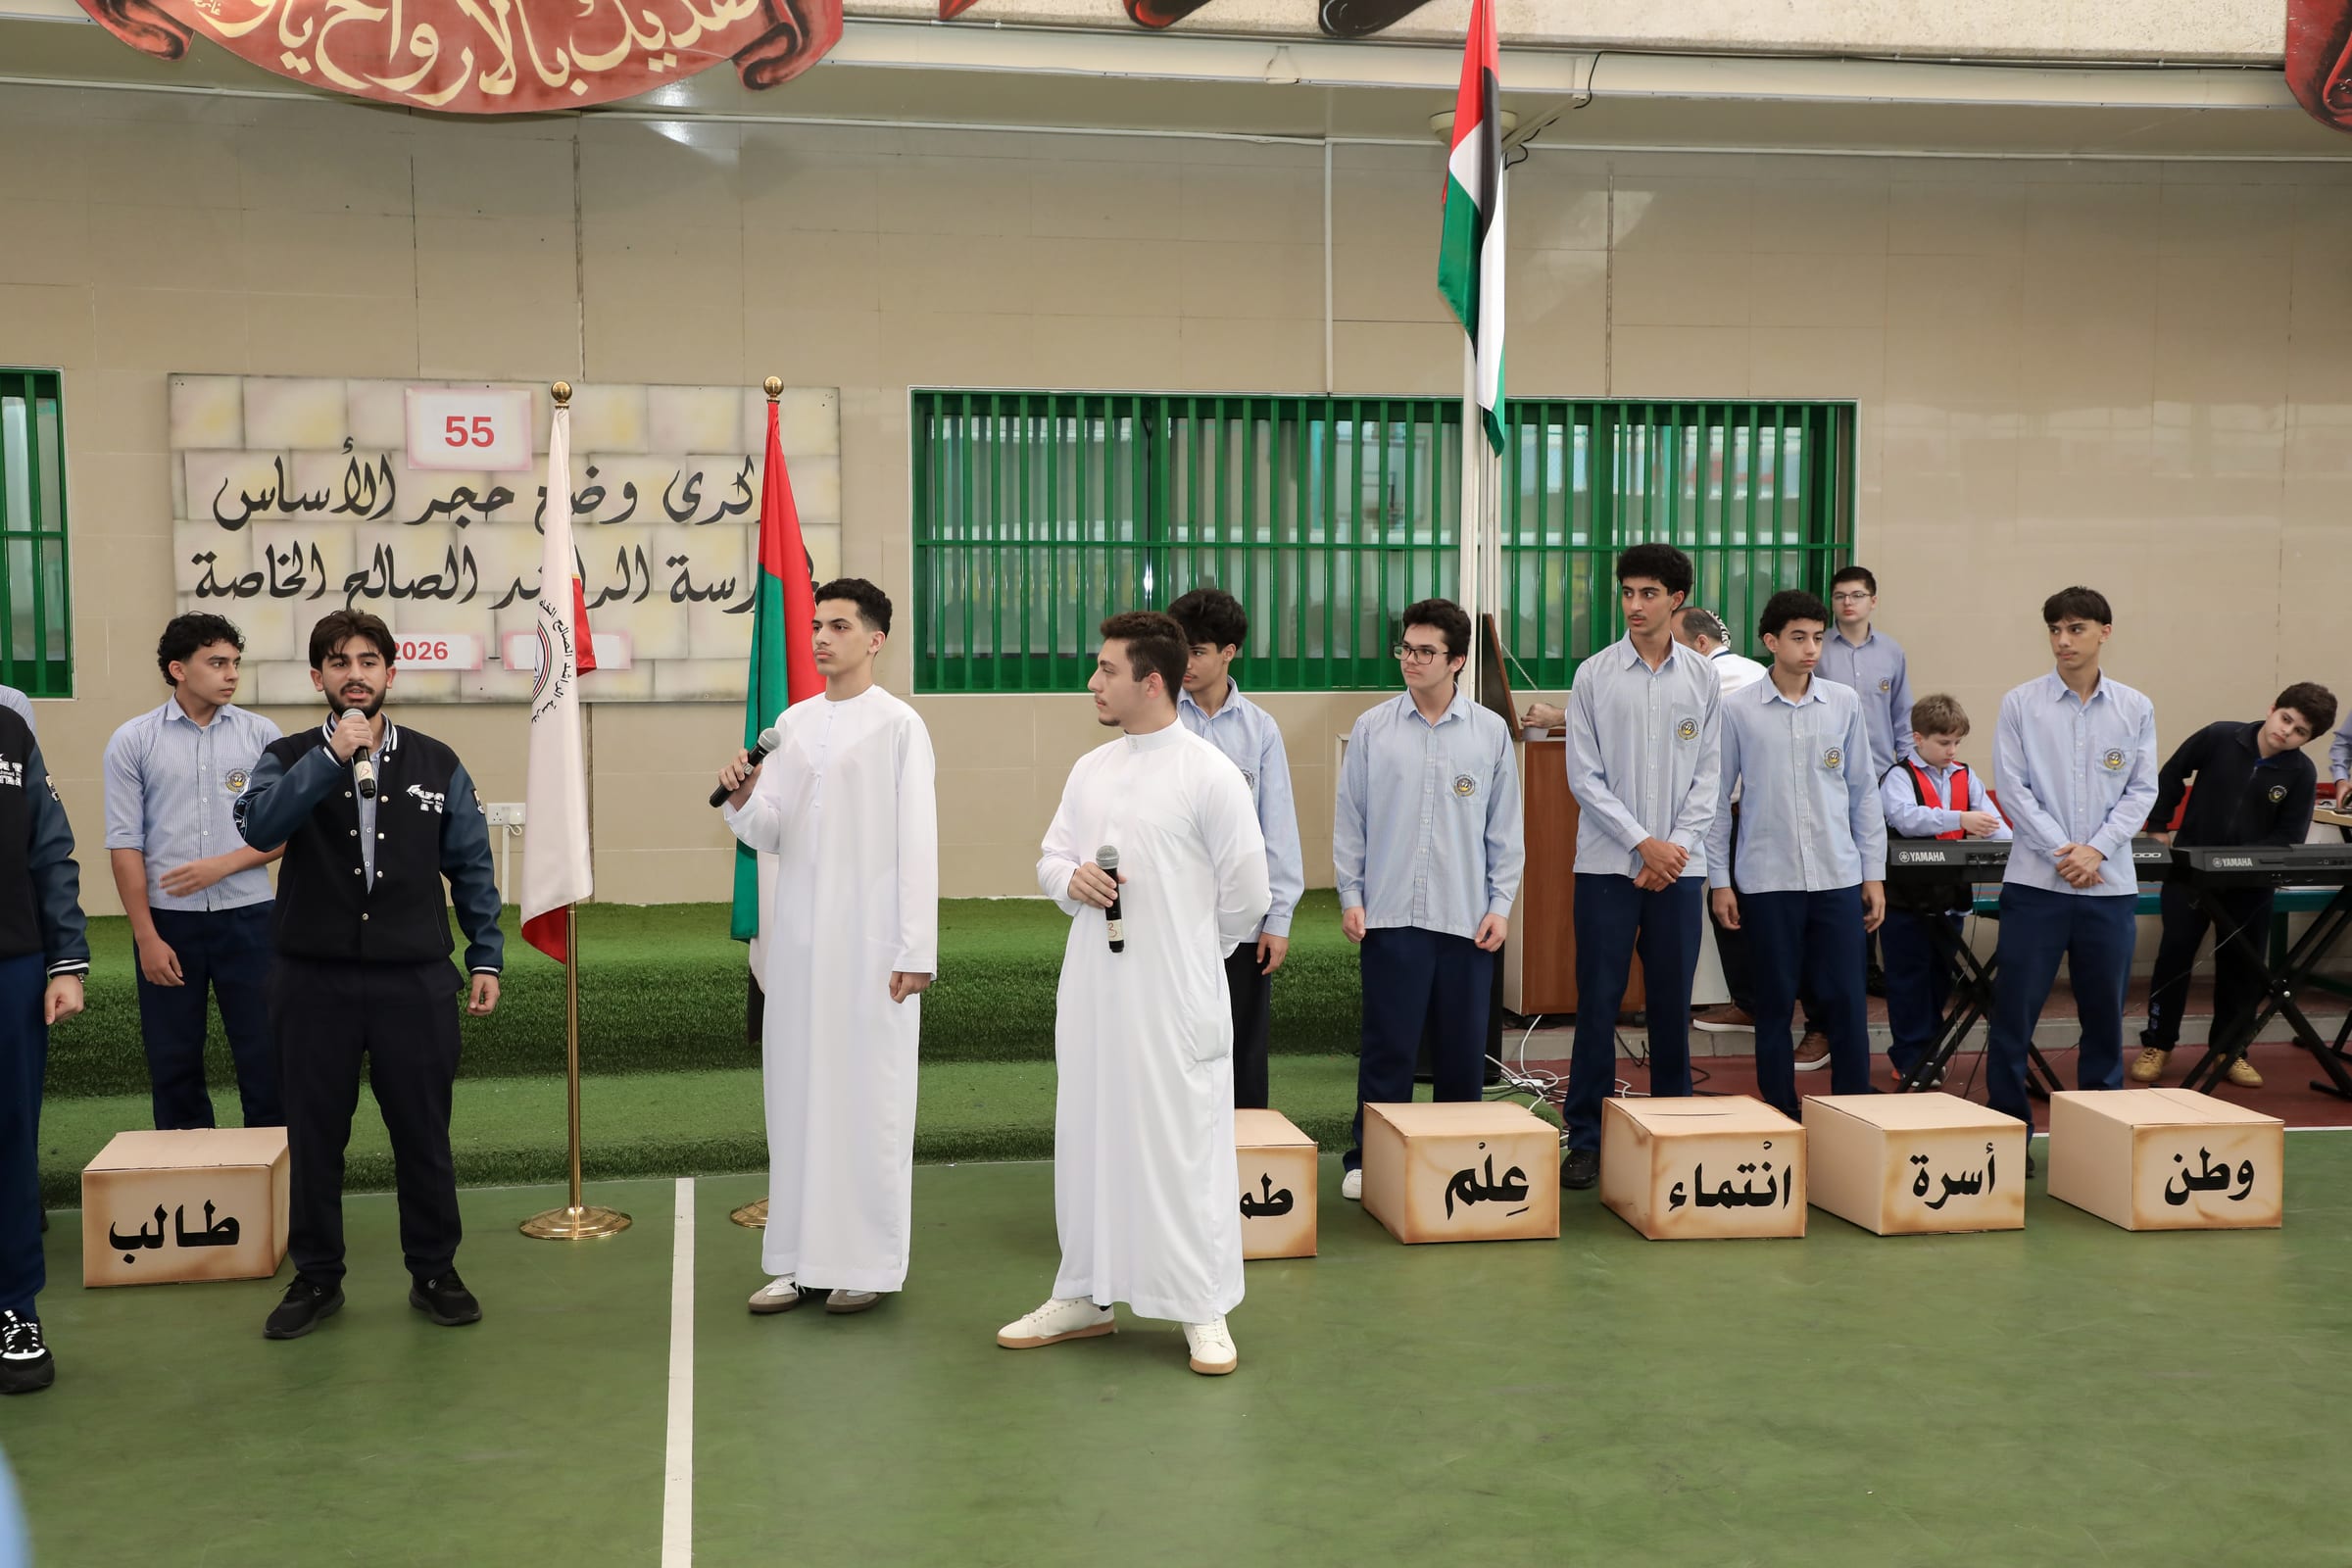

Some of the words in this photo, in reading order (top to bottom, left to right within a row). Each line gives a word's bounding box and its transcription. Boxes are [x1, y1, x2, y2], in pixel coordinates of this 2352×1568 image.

[569, 0, 760, 73] ديك
[445, 416, 495, 448] 55
[213, 436, 396, 531] الأساس
[404, 486, 514, 529] حجر
[662, 455, 761, 525] كرى
[191, 540, 326, 601] الخاصة
[343, 542, 478, 611] الصالح
[488, 544, 651, 610] الراد
[539, 599, 558, 618] الخا
[552, 618, 573, 657] الصالح
[1910, 851, 1946, 862] YAMAHA
[2221, 858, 2253, 867] YAMAHA
[1909, 1142, 1995, 1210] أسرة
[2164, 1147, 2255, 1206] وطن
[109, 1199, 240, 1264] طالب
